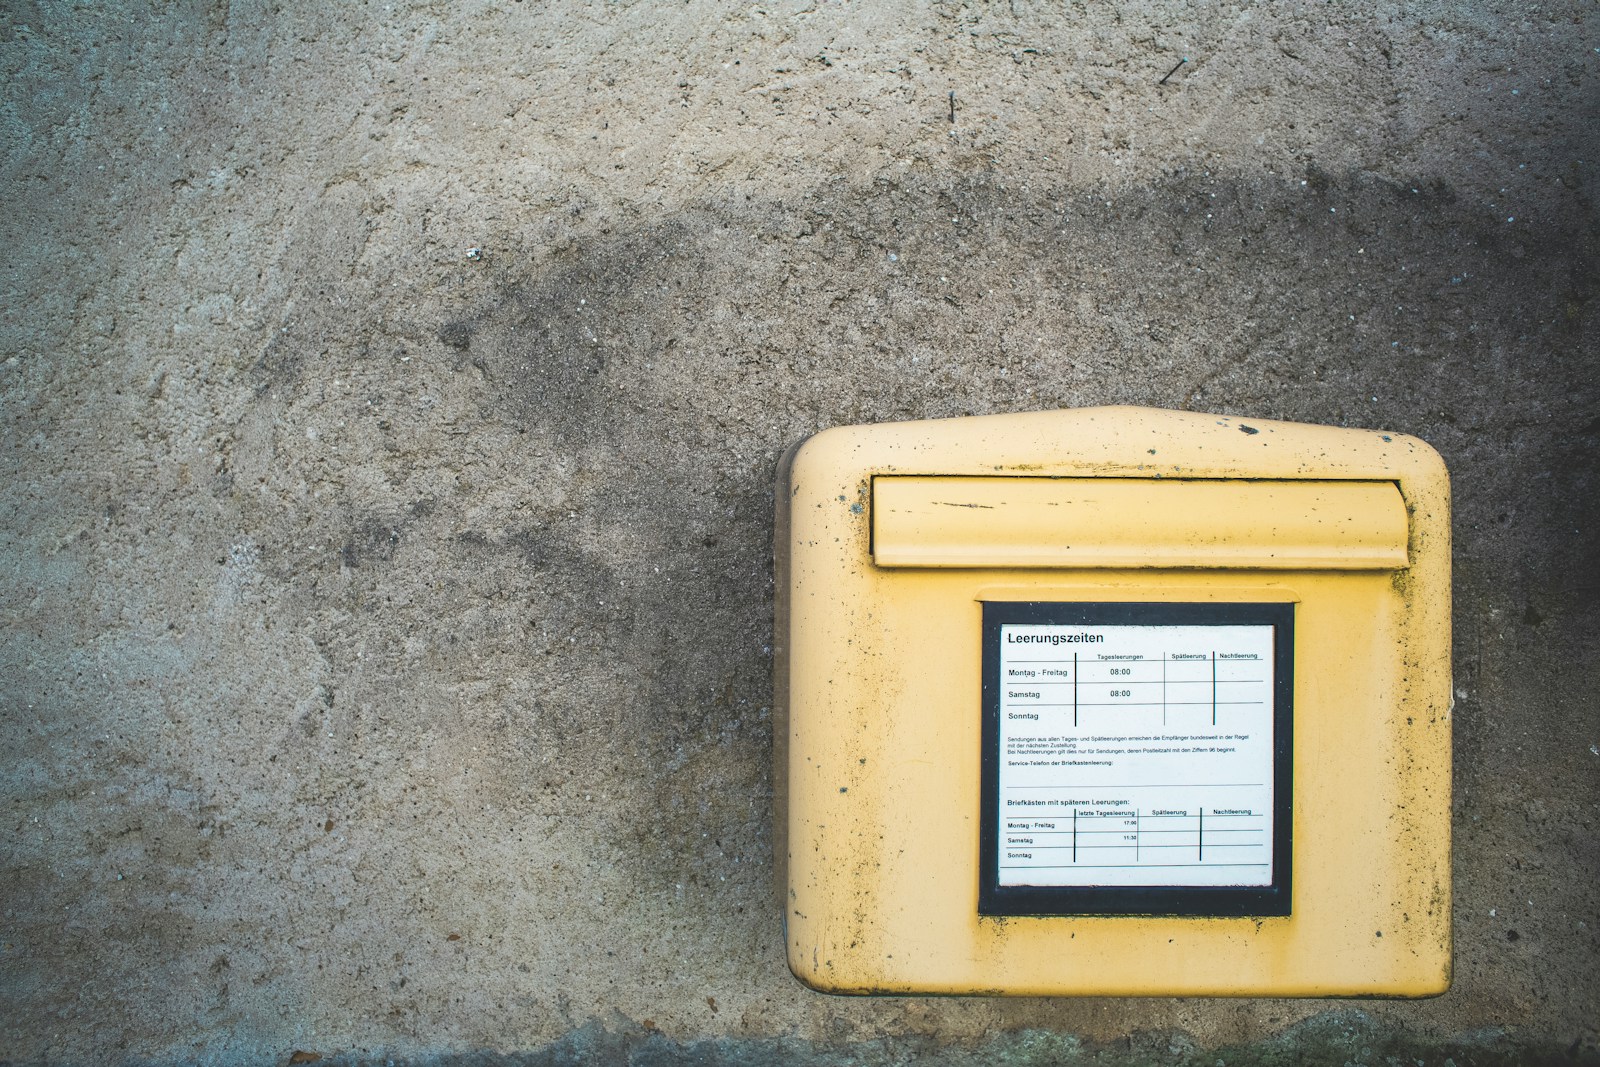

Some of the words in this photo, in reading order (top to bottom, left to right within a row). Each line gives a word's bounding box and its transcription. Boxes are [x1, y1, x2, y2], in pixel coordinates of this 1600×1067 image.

[1008, 633, 1104, 645] Leerungszeiten
[1008, 669, 1036, 677] Montag
[1042, 669, 1068, 677] Freitag
[1008, 691, 1040, 699] Samstag
[1060, 798, 1090, 807] späteren
